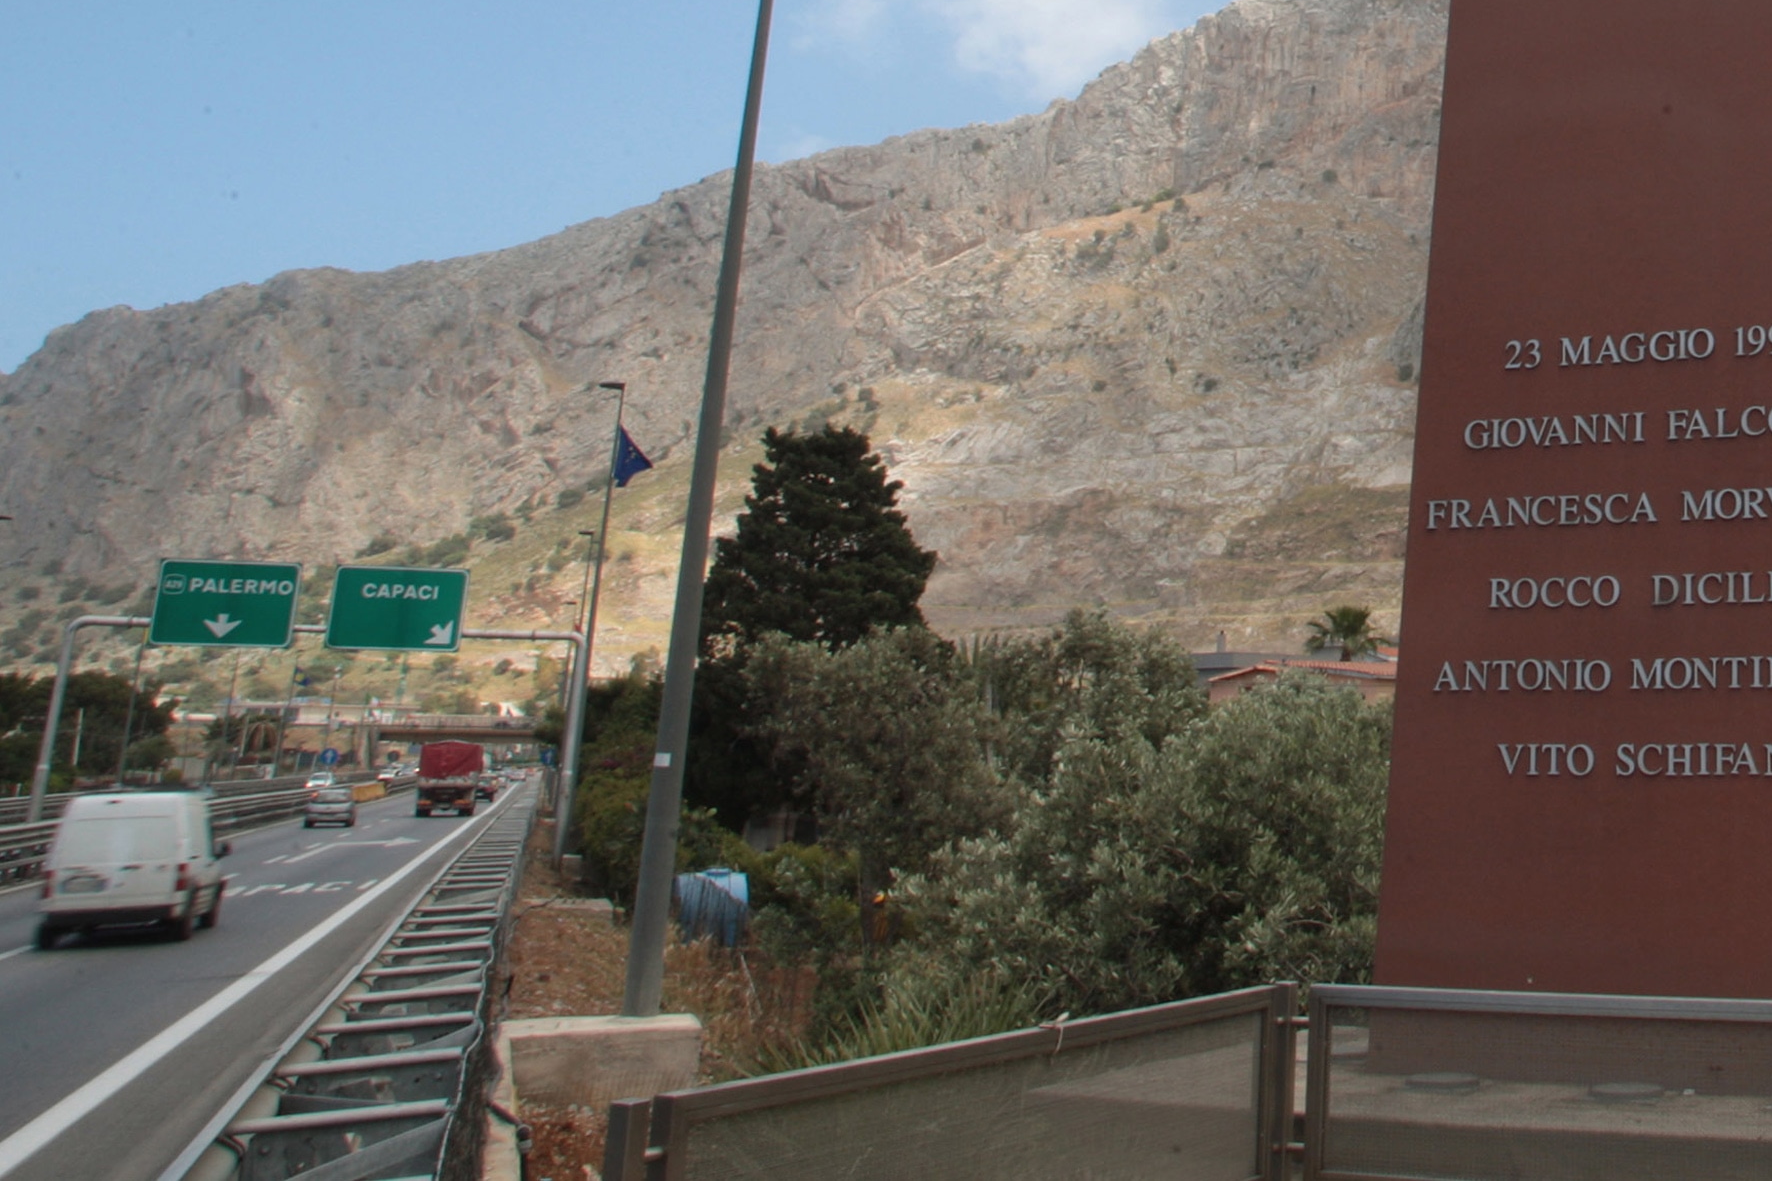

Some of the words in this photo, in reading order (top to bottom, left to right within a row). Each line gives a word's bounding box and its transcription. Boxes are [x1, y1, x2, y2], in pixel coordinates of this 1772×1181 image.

[1504, 338, 1542, 370] 23
[1559, 327, 1715, 367] MAGGIO
[1463, 412, 1645, 450] GIOVANNI
[1426, 492, 1658, 529] FRANCESCA
[189, 577, 294, 595] PALERMO
[361, 582, 439, 600] CAPACI
[1489, 574, 1621, 609] ROCCO
[1433, 658, 1613, 692] ANTONIO
[1498, 742, 1596, 776] VITO
